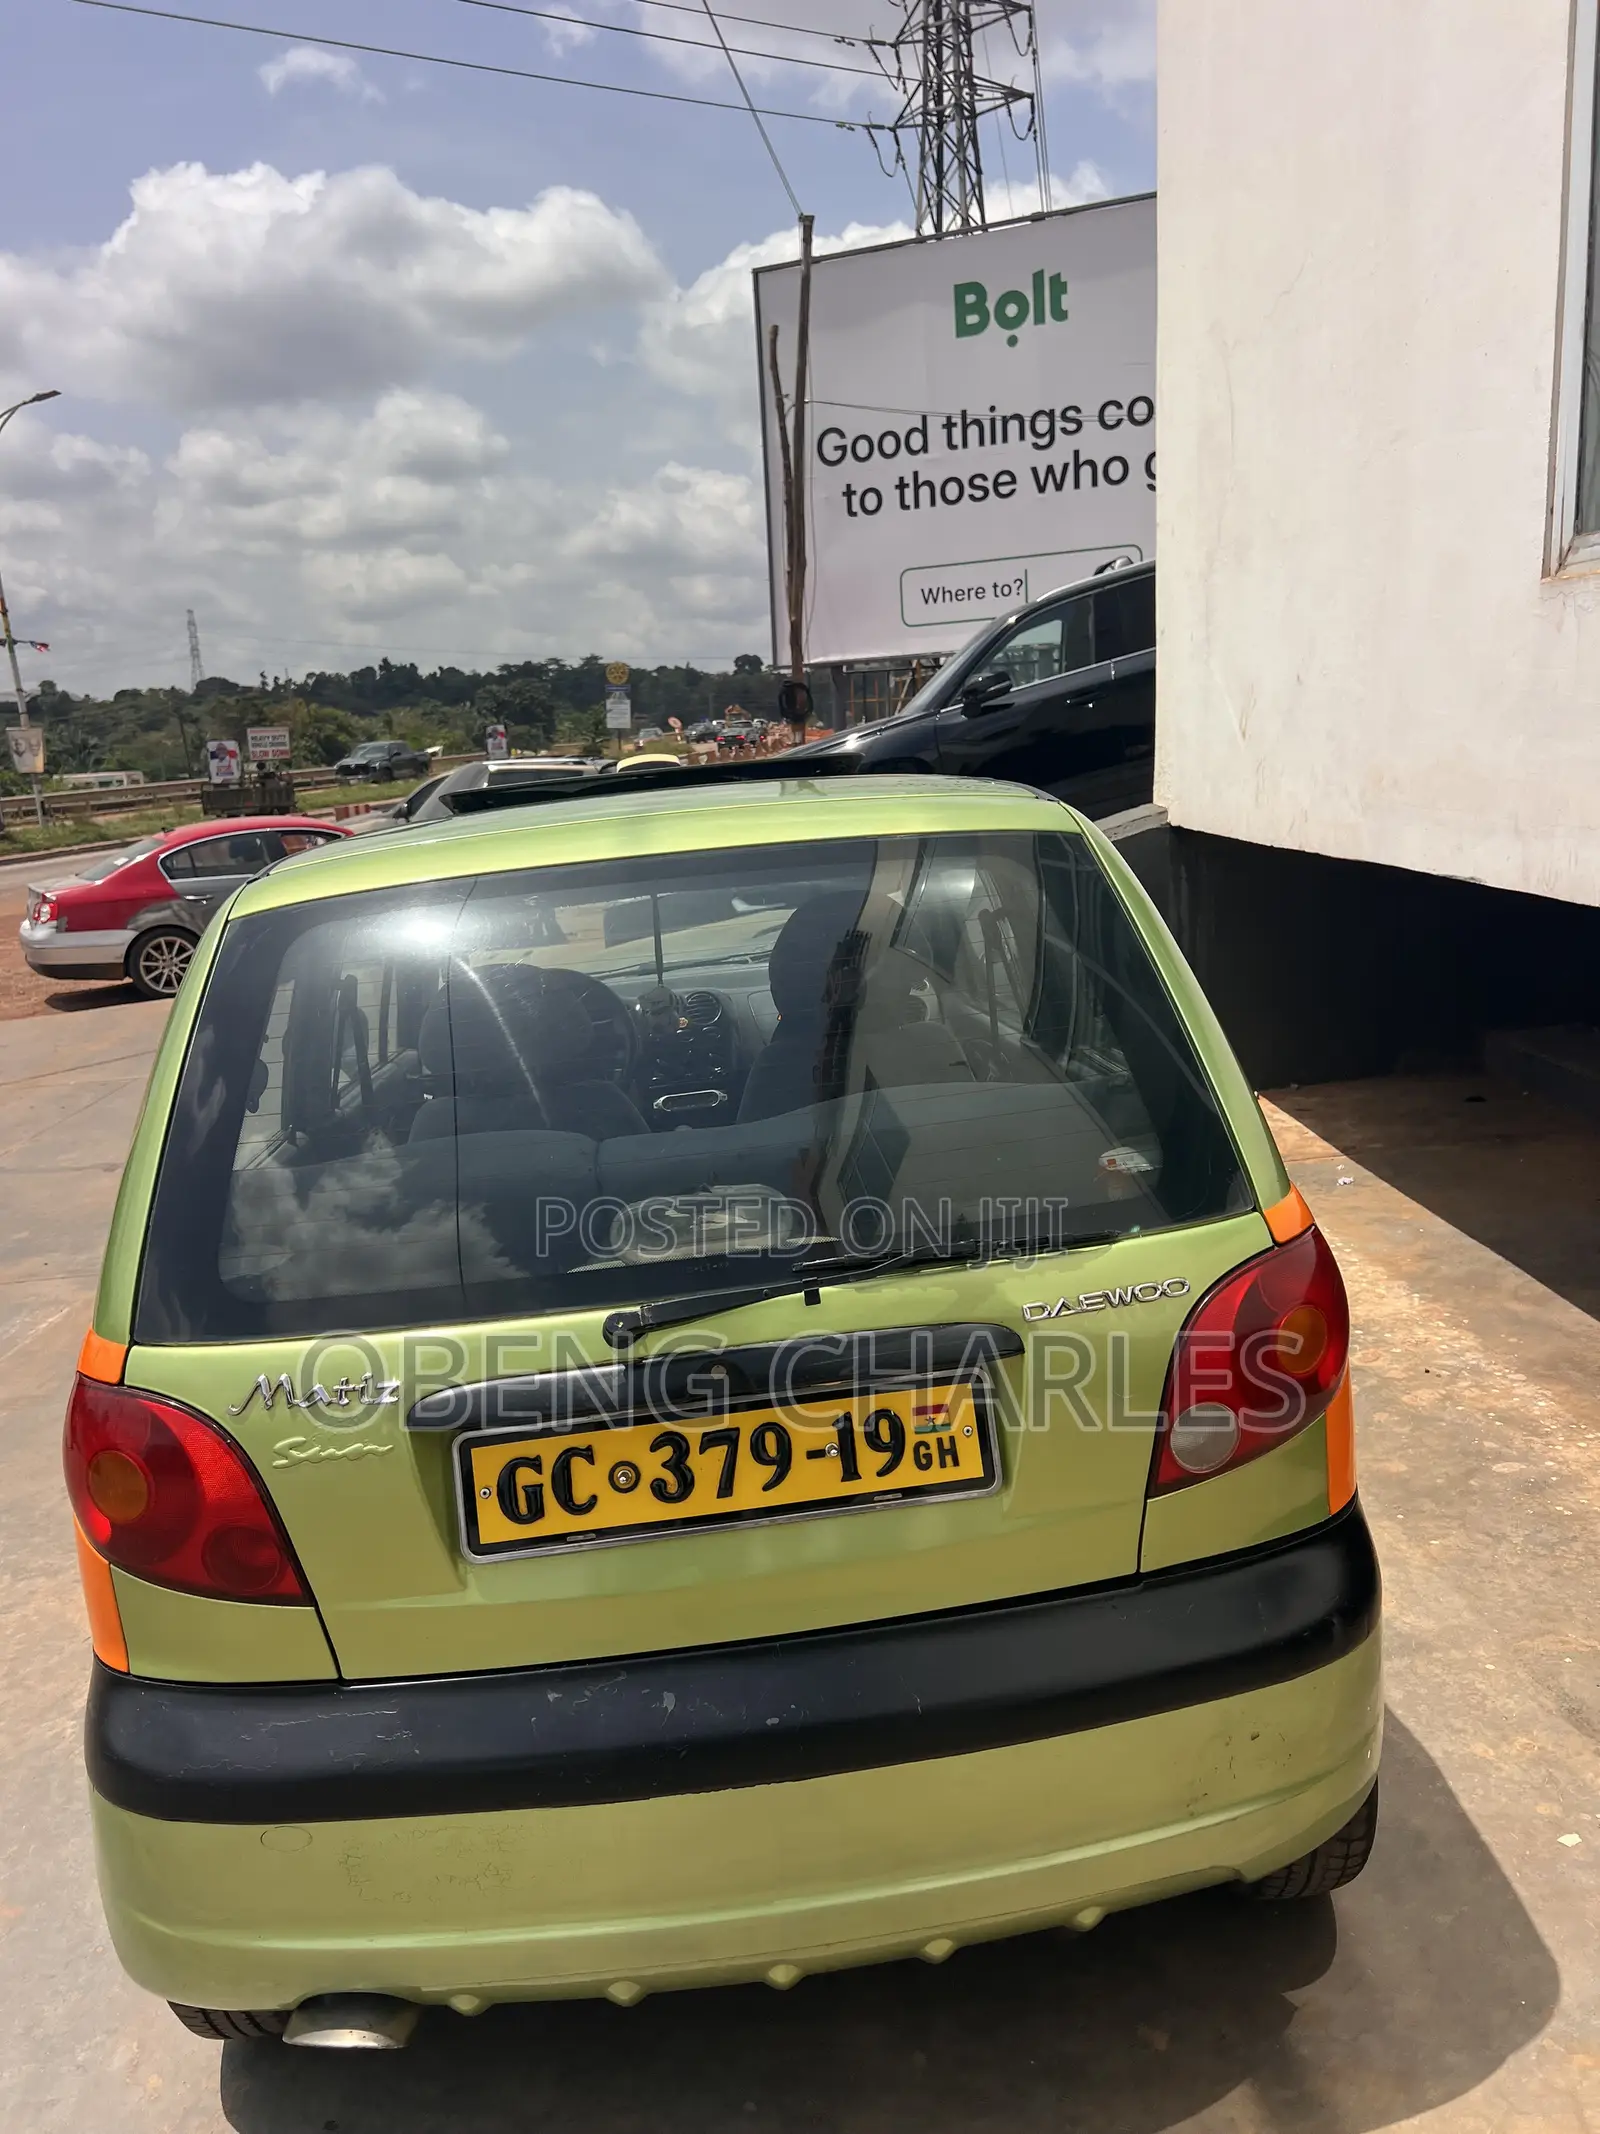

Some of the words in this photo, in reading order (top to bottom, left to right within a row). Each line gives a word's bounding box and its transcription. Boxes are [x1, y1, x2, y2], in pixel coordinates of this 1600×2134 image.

[953, 268, 1069, 348] Bolt
[816, 414, 929, 467] Good
[942, 405, 1083, 451] things
[842, 482, 883, 518] to
[894, 468, 1018, 512] those
[1030, 448, 1130, 495] who
[920, 583, 987, 605] Where
[991, 577, 1024, 599] to?
[1021, 1276, 1191, 1322] DAEWOO
[227, 1371, 402, 1416] Matiz
[495, 1445, 598, 1525] GC
[649, 1407, 907, 1504] 379-19
[912, 1435, 961, 1472] GH
